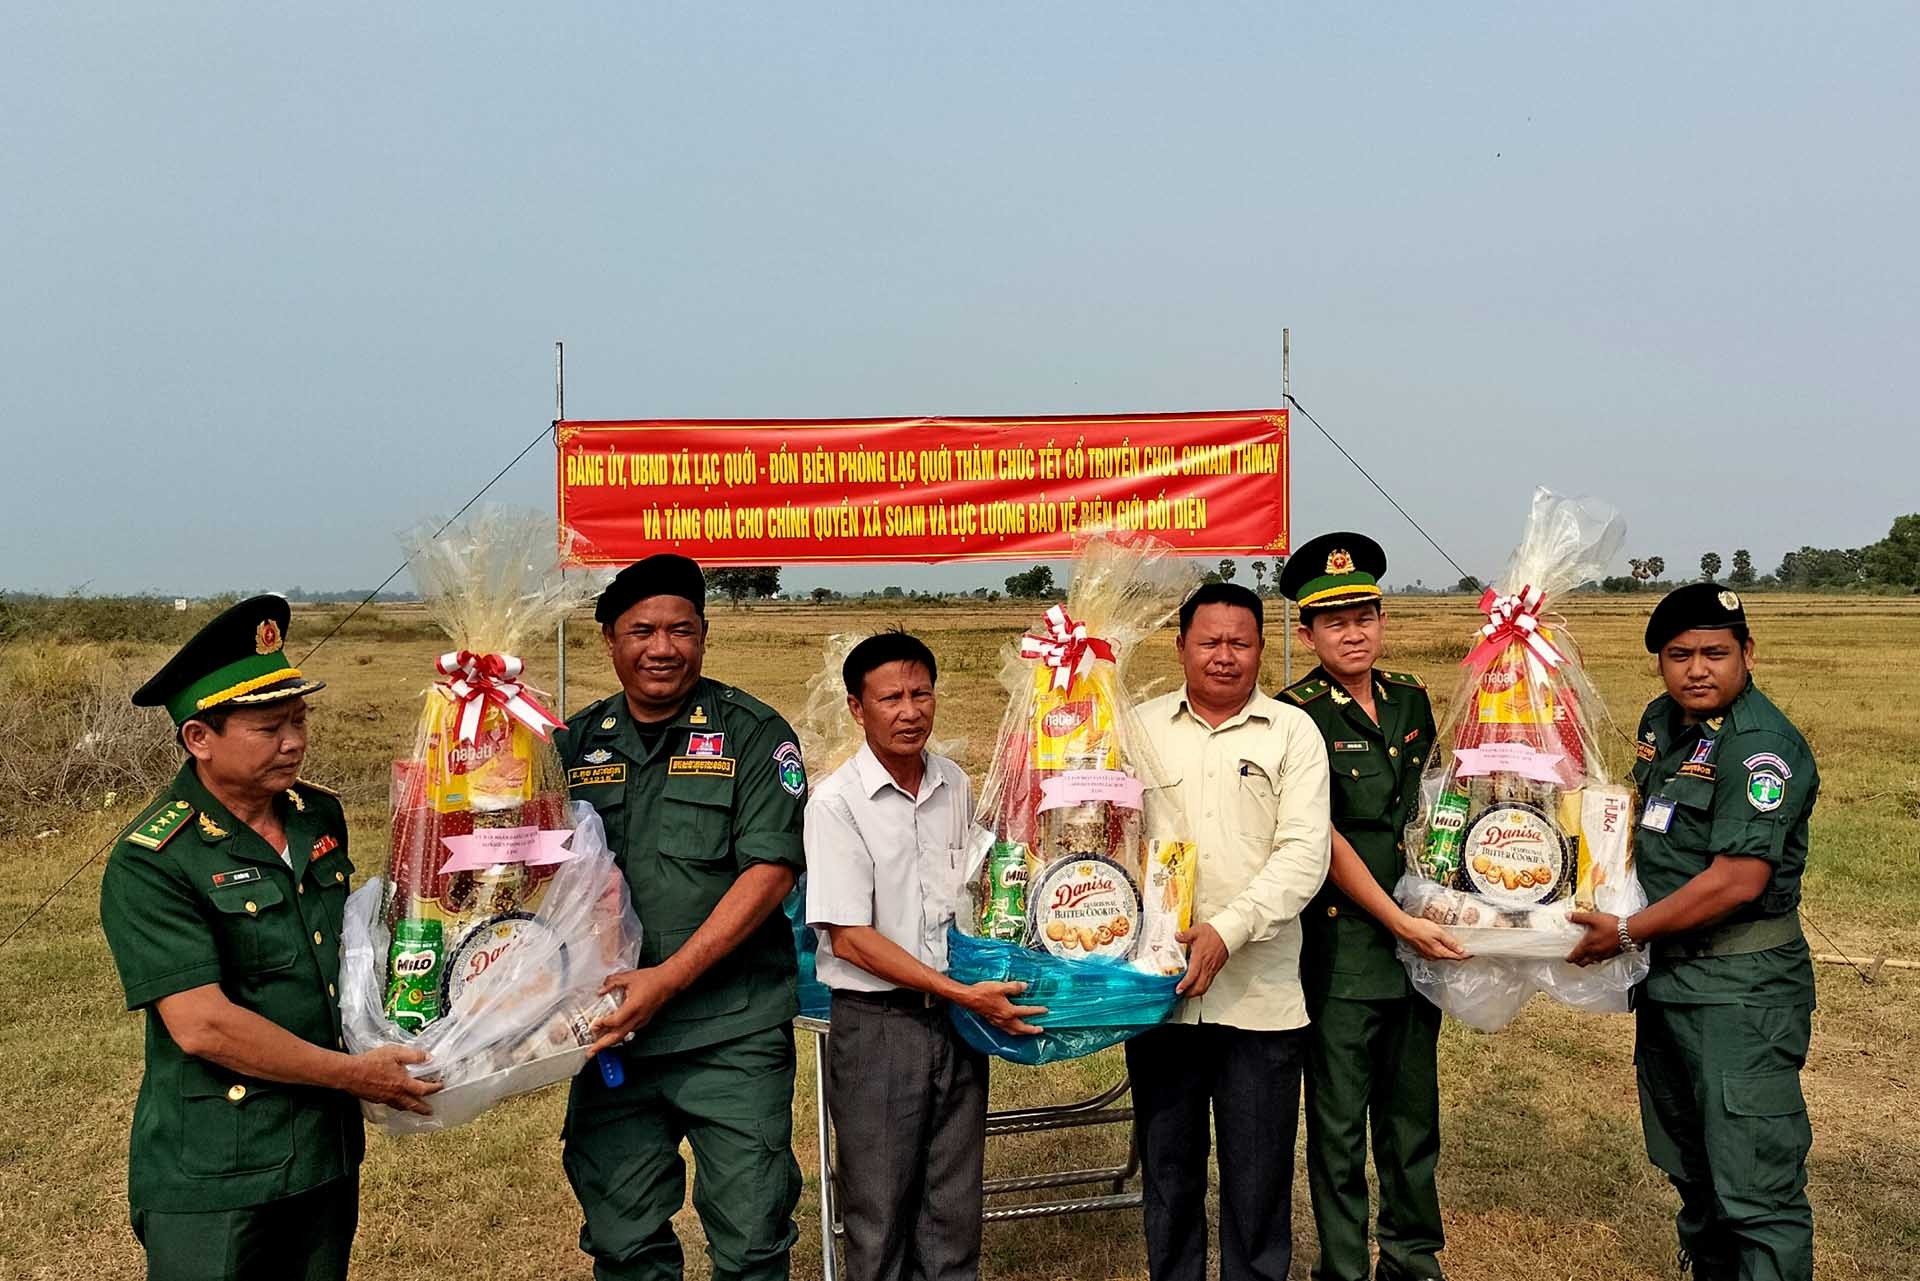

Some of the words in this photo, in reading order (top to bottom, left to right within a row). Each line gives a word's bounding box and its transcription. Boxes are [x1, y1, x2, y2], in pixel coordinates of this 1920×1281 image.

[567, 444, 604, 486] ĐẢNG
[608, 444, 627, 490] ỦY,
[630, 454, 668, 486] UBND
[671, 448, 691, 485] XÃ
[694, 453, 720, 492] LẠC
[724, 446, 757, 488] QUỚI
[769, 441, 799, 484] ĐỒN
[802, 445, 835, 484] BIÊN
[838, 443, 886, 483] PHÒNG
[890, 452, 915, 489] LẠC
[919, 443, 952, 485] QUỚI
[956, 443, 995, 481] THĂM
[998, 443, 1035, 481] CHÚC
[1038, 438, 1062, 479] TẾT
[1065, 435, 1085, 479] CỔ
[1087, 437, 1140, 478] TRUYỀN
[1143, 446, 1179, 477] CHOL
[1181, 445, 1231, 475] CHNAM
[1235, 443, 1280, 474] THMAY
[643, 502, 662, 540] VÀ
[664, 502, 701, 547] TẶNG
[704, 501, 733, 543] QUÀ
[736, 507, 763, 539] CHO
[767, 500, 810, 538] CHÍNH
[813, 496, 859, 541] QUYỀN
[862, 498, 882, 537] XÃ
[885, 505, 925, 537] SOAM
[928, 498, 947, 536] VÀ
[951, 501, 977, 542] LỰC
[980, 501, 1025, 542] LƯỢNG
[1029, 492, 1057, 533] BẢO
[1060, 495, 1077, 539] VỆ
[1080, 495, 1112, 531] BIÊN
[1116, 494, 1144, 531] GIỚI
[1147, 488, 1171, 530] ĐỐI
[1174, 493, 1207, 536] DIỆN
[1434, 815, 1461, 828] MILO
[1603, 797, 1619, 832] HURA
[1480, 825, 1544, 848] Danisa
[1051, 875, 1117, 909] Danisa
[397, 958, 432, 972] MILO
